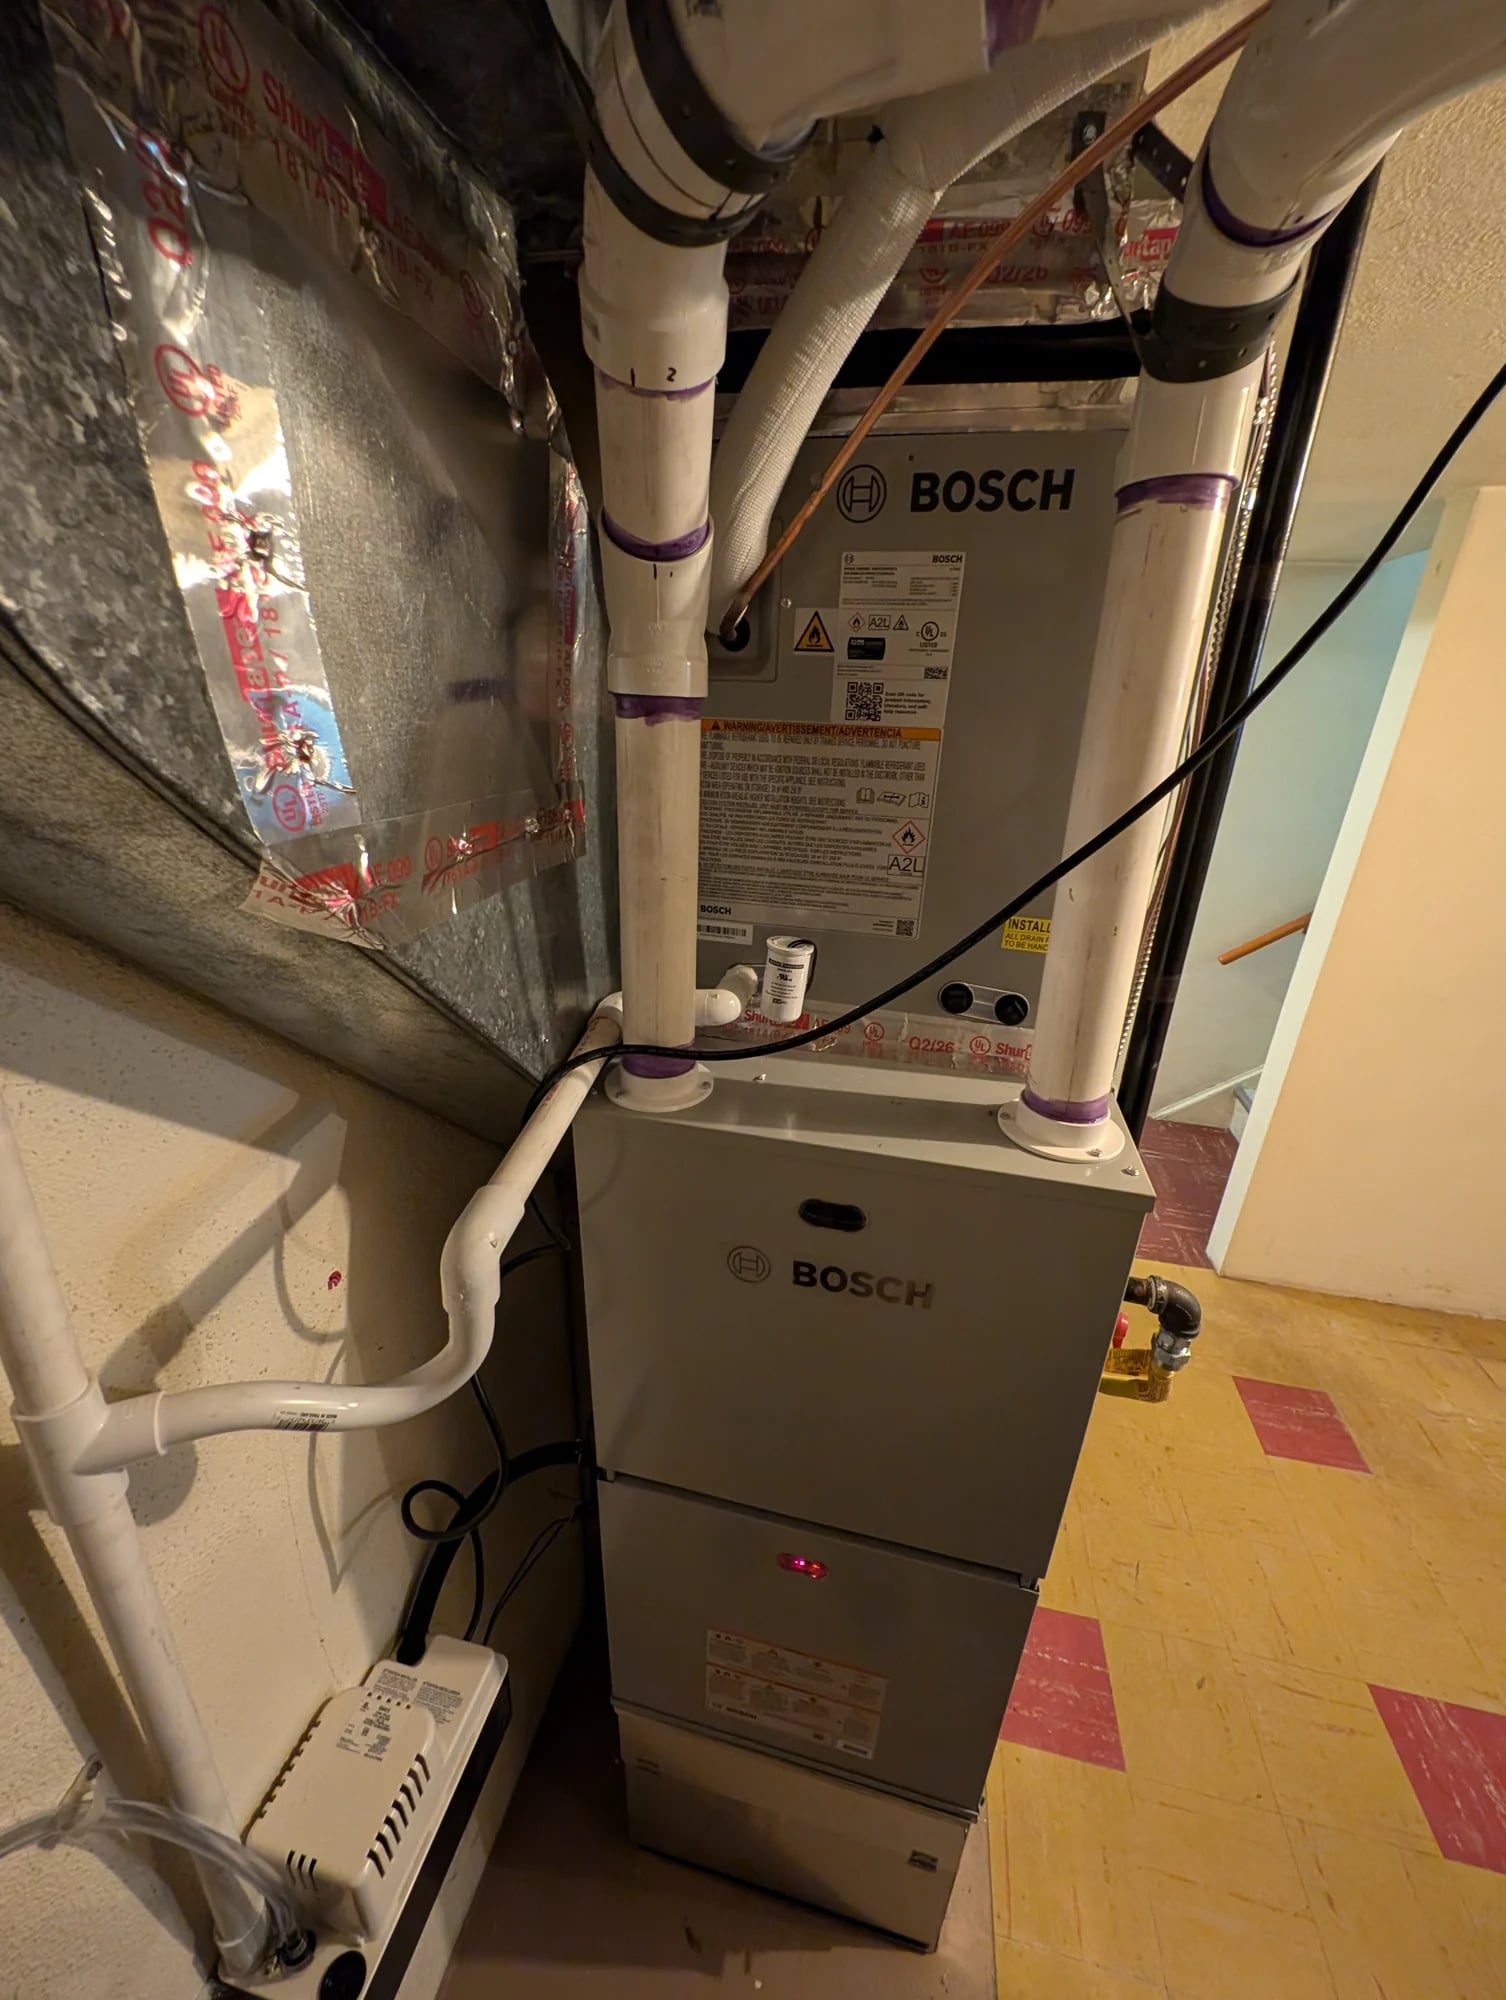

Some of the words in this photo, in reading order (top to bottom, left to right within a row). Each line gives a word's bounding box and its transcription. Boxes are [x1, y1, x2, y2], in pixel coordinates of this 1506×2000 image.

[665, 366, 677, 382] 2
[910, 469, 1075, 512] BOSCH
[932, 555, 963, 563] BOSCH
[869, 617, 889, 628] A2L
[723, 721, 902, 738] WARNING/AVERTISSEMENT/ADVERTENCIA
[888, 856, 923, 873] A2L
[700, 905, 732, 915] BOSCH
[1005, 932, 1019, 941] ALL
[1020, 933, 1044, 943] DRAIN
[1016, 941, 1026, 949] BE
[909, 1036, 955, 1052] Q2/26
[792, 1260, 935, 1309] BOSCH
